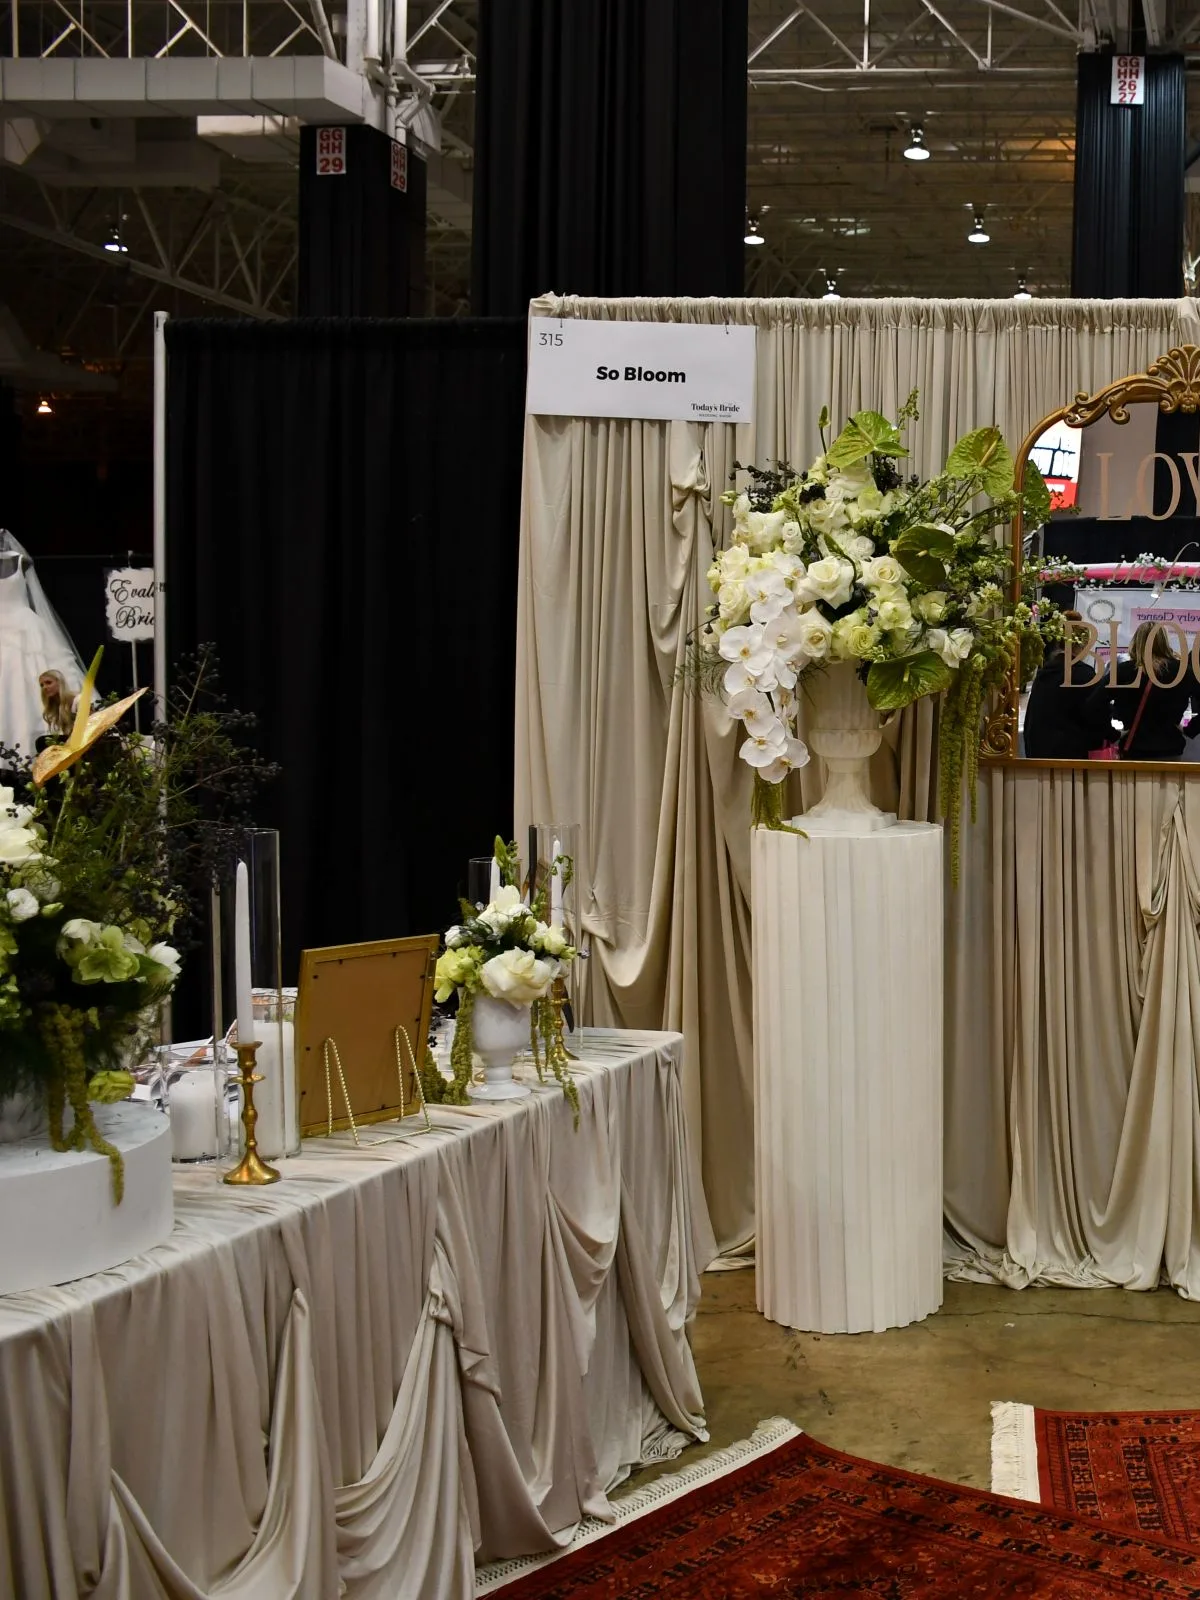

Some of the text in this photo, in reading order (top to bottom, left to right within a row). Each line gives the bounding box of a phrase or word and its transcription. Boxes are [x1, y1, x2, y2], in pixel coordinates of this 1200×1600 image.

[1117, 56, 1140, 68] GG
[1117, 68, 1139, 79] HH
[1118, 80, 1137, 91] 26
[1118, 92, 1137, 103] 27
[319, 128, 343, 141] GG
[319, 142, 342, 155] HH
[319, 157, 344, 173] 29
[392, 171, 406, 190] 29
[538, 332, 564, 347] 315
[596, 366, 686, 383] So Bloom
[691, 402, 740, 413] Today's Bride
[109, 578, 154, 606] Eval
